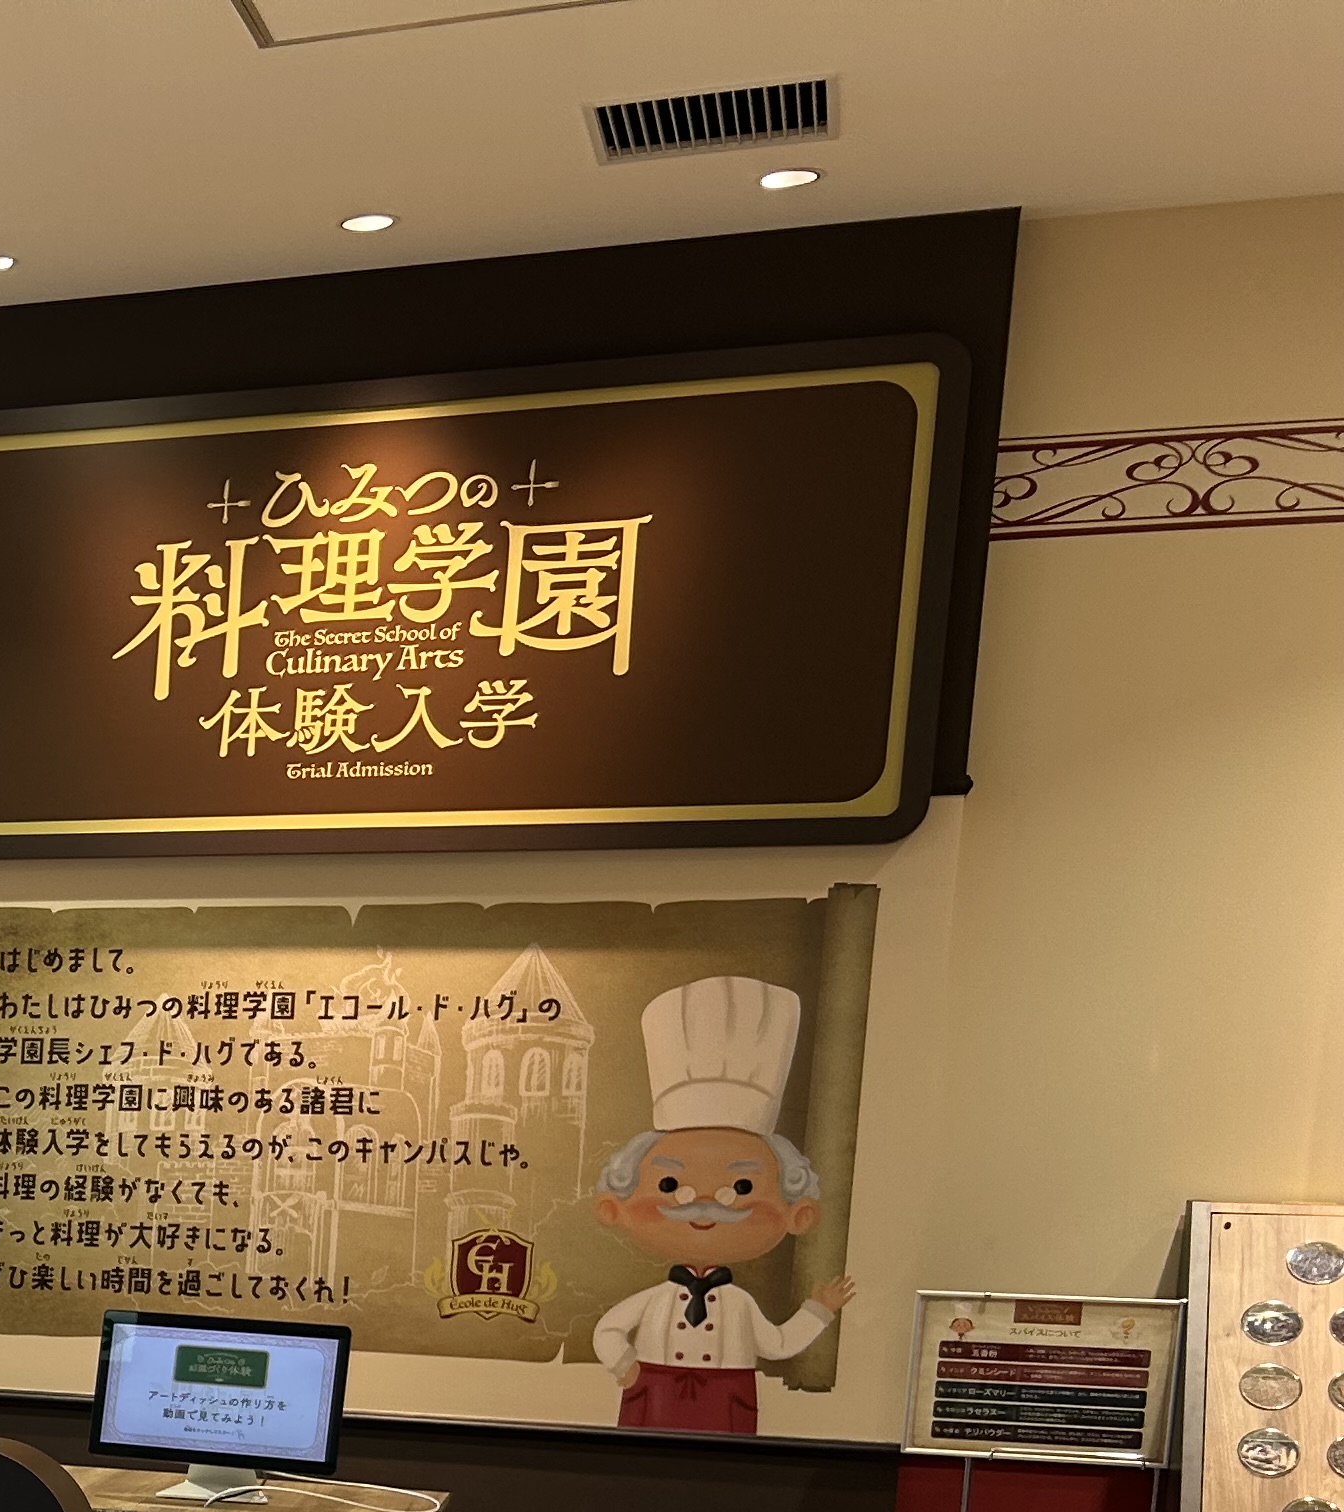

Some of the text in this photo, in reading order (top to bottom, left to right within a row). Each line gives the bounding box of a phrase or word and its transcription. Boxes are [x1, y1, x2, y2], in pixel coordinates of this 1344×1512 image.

[263, 463, 499, 529] ひみつの
[113, 514, 655, 701] 料理学園
[274, 622, 463, 648] The Secret School of
[265, 644, 465, 681] Culinary Arts
[199, 679, 538, 759] 体験入学
[286, 761, 434, 779] Trial Admission
